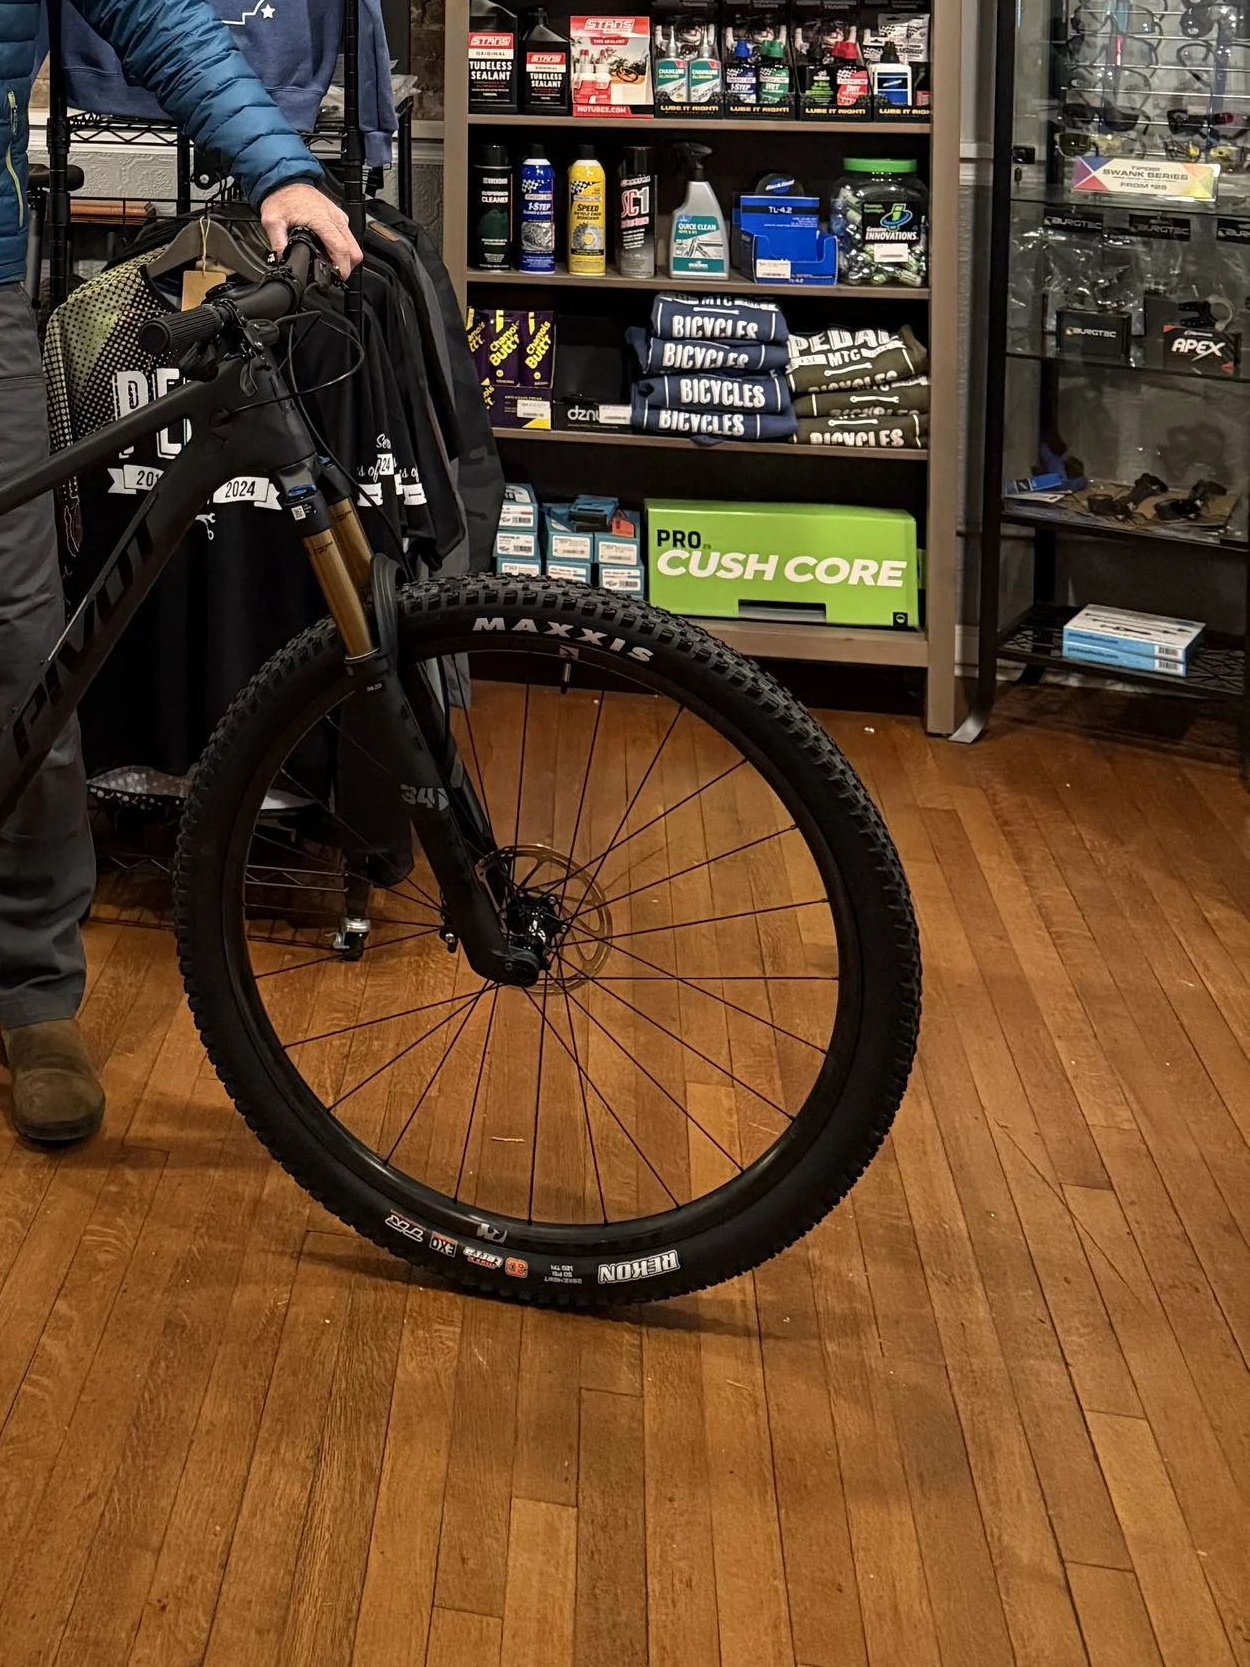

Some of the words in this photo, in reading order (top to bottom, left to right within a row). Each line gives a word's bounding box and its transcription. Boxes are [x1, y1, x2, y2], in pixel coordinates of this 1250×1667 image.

[469, 61, 512, 70] TUBELESS
[471, 71, 510, 80] SEALANT
[577, 106, 627, 114] NOTUBES.COM
[1103, 169, 1144, 177] SWANK
[1147, 172, 1188, 180] SERIES
[528, 202, 551, 210] 1-STEP
[621, 186, 649, 218] SC1
[768, 206, 792, 214] TL-4.2
[678, 223, 696, 231] QUICK
[697, 223, 716, 231] CLEAN
[1051, 217, 1102, 230] BURGTEC
[865, 231, 919, 241] INNOVATIONS
[672, 315, 758, 339] BICYCLES
[1074, 327, 1116, 338] BURGTEC
[787, 329, 892, 358] PEDAL
[1172, 338, 1226, 361] APEX
[662, 343, 749, 369] BICYCLES
[828, 349, 861, 367] MTC
[680, 379, 765, 408] BICYCLES
[658, 410, 745, 436] BICYCLES
[225, 481, 255, 498] 2024
[656, 529, 702, 549] PRO
[657, 550, 779, 581] CUSH
[784, 556, 907, 588] CORE
[472, 617, 654, 662] MAXXIS
[400, 784, 436, 809] 34
[430, 1235, 455, 1256] EXO
[598, 1249, 681, 1284] REKON
